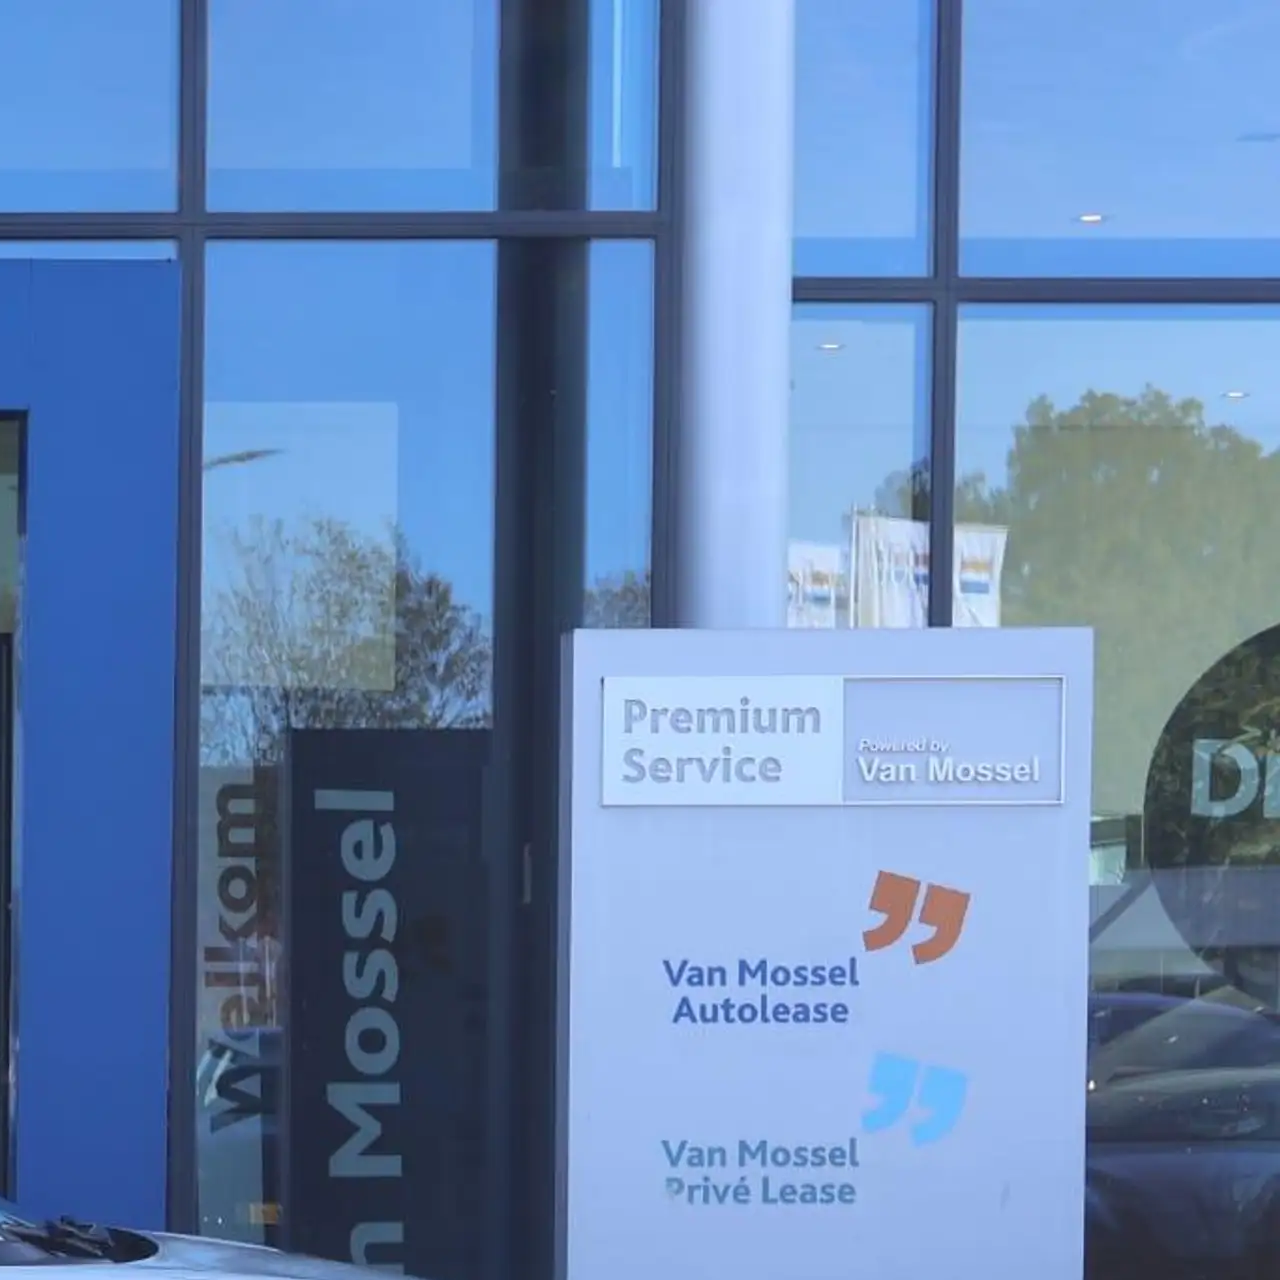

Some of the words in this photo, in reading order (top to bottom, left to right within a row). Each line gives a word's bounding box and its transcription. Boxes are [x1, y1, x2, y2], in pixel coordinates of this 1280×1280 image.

[623, 695, 822, 736] Premium
[621, 745, 784, 784] Service
[858, 755, 917, 783] Van
[928, 755, 1040, 783] Mossel
[314, 788, 404, 1178] Mossel
[662, 958, 727, 987] Van
[738, 956, 860, 987] Mossel
[672, 993, 850, 1024] Autolease
[661, 1139, 727, 1168] Van
[738, 1136, 860, 1168] Mossel
[665, 1175, 751, 1205] Privé
[761, 1175, 857, 1205] Lease
